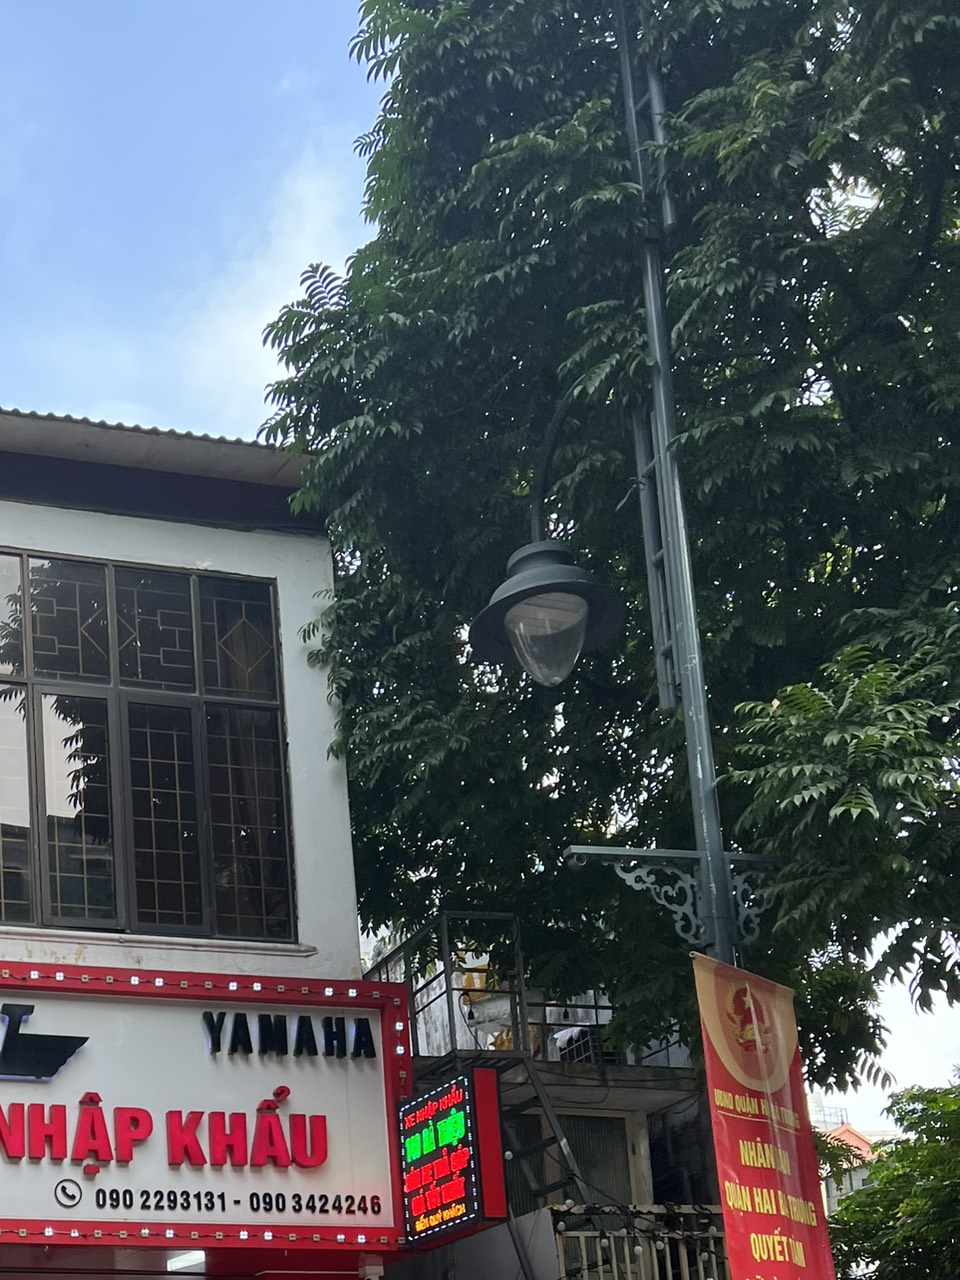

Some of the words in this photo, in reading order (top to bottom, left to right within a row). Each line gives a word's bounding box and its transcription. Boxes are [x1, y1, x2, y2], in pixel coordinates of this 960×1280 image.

[202, 1011, 377, 1060] YAMAHA
[166, 1086, 329, 1169] KHẨU
[739, 1137, 776, 1169] NHÂN
[724, 1179, 752, 1216] QUẬN
[753, 1187, 777, 1215] HAI
[750, 1227, 789, 1263] QUYẾT
